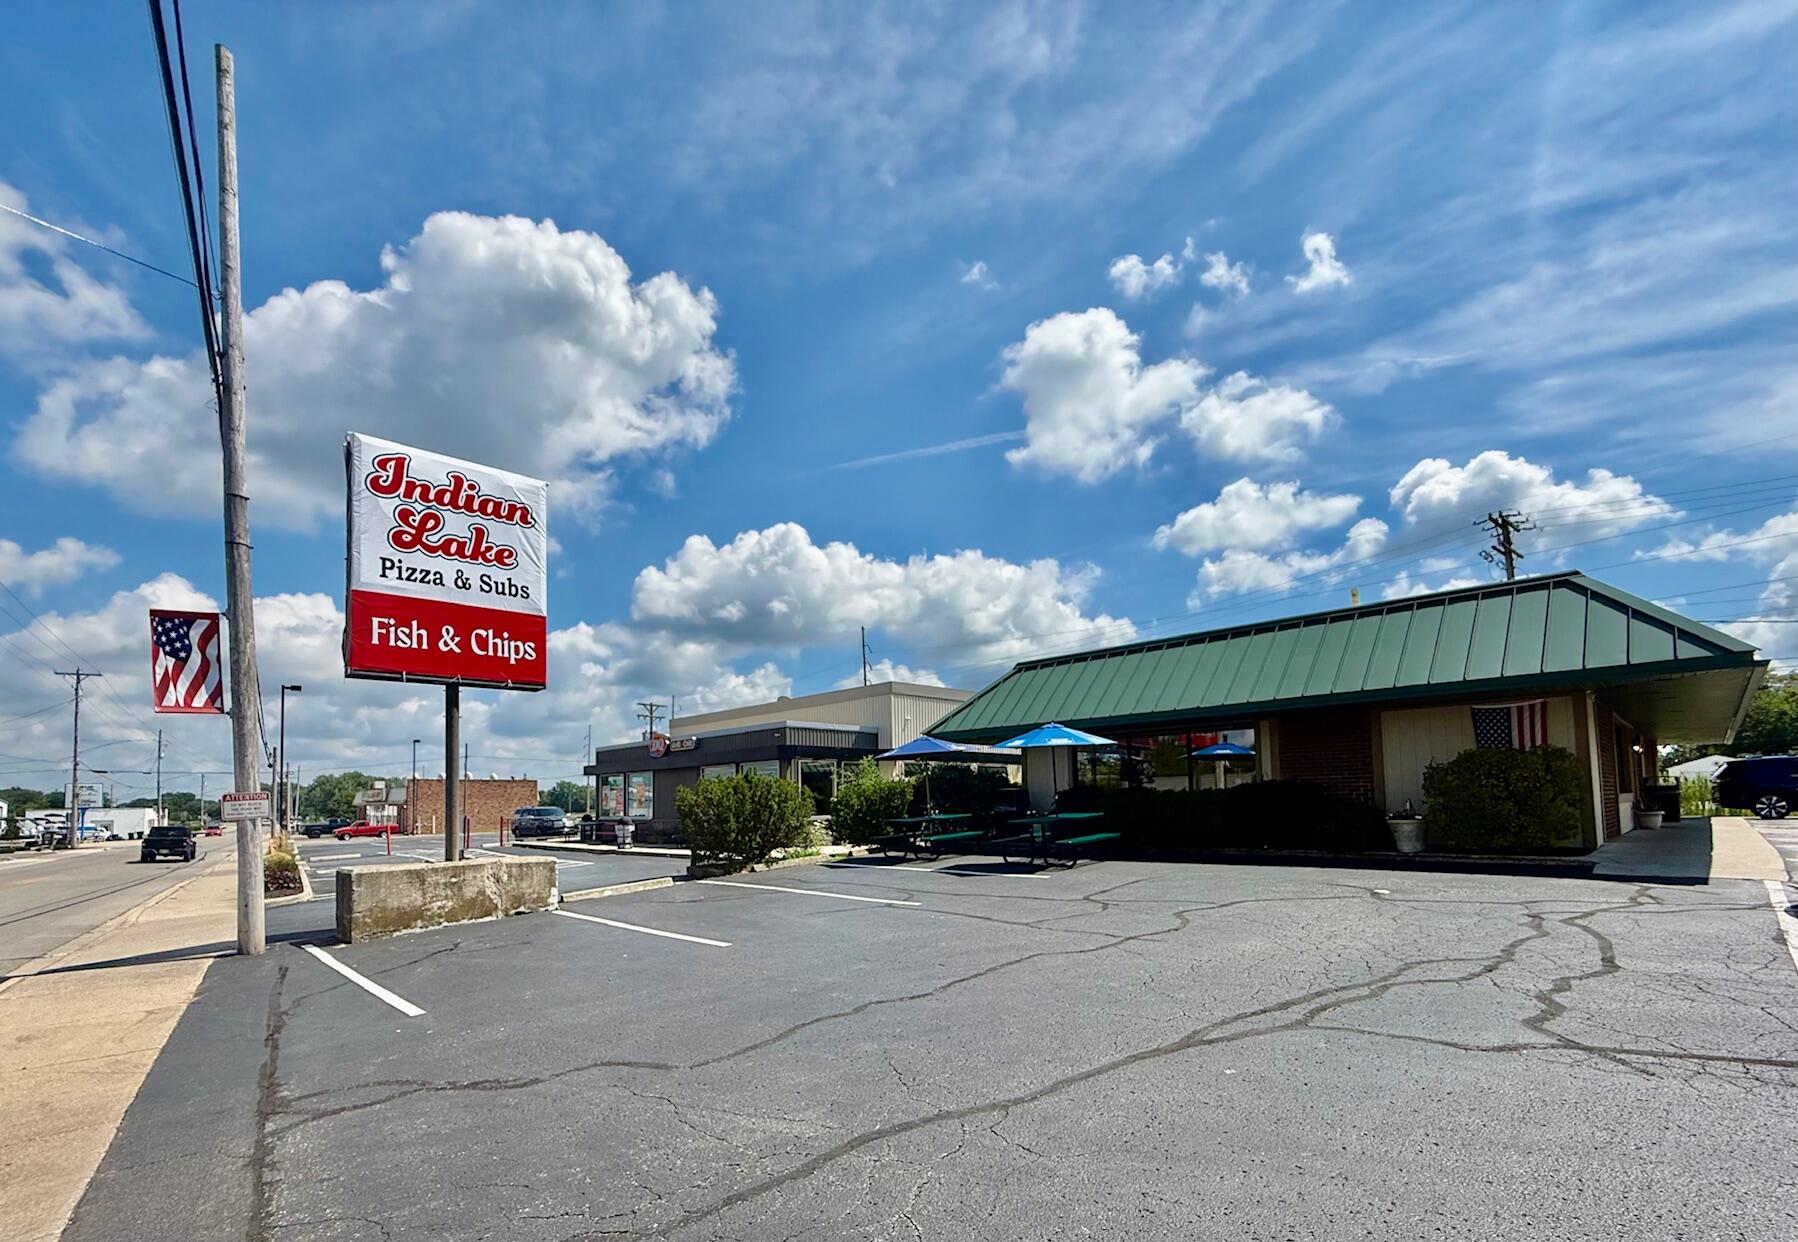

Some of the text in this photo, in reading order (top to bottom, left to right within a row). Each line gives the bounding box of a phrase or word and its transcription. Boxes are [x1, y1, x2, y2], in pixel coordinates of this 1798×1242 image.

[365, 453, 536, 527] Indian
[388, 504, 518, 570] Lake
[379, 556, 530, 599] Pizza & Subs
[371, 616, 537, 664] Fish & Chips
[225, 793, 267, 801] ATTENTION
